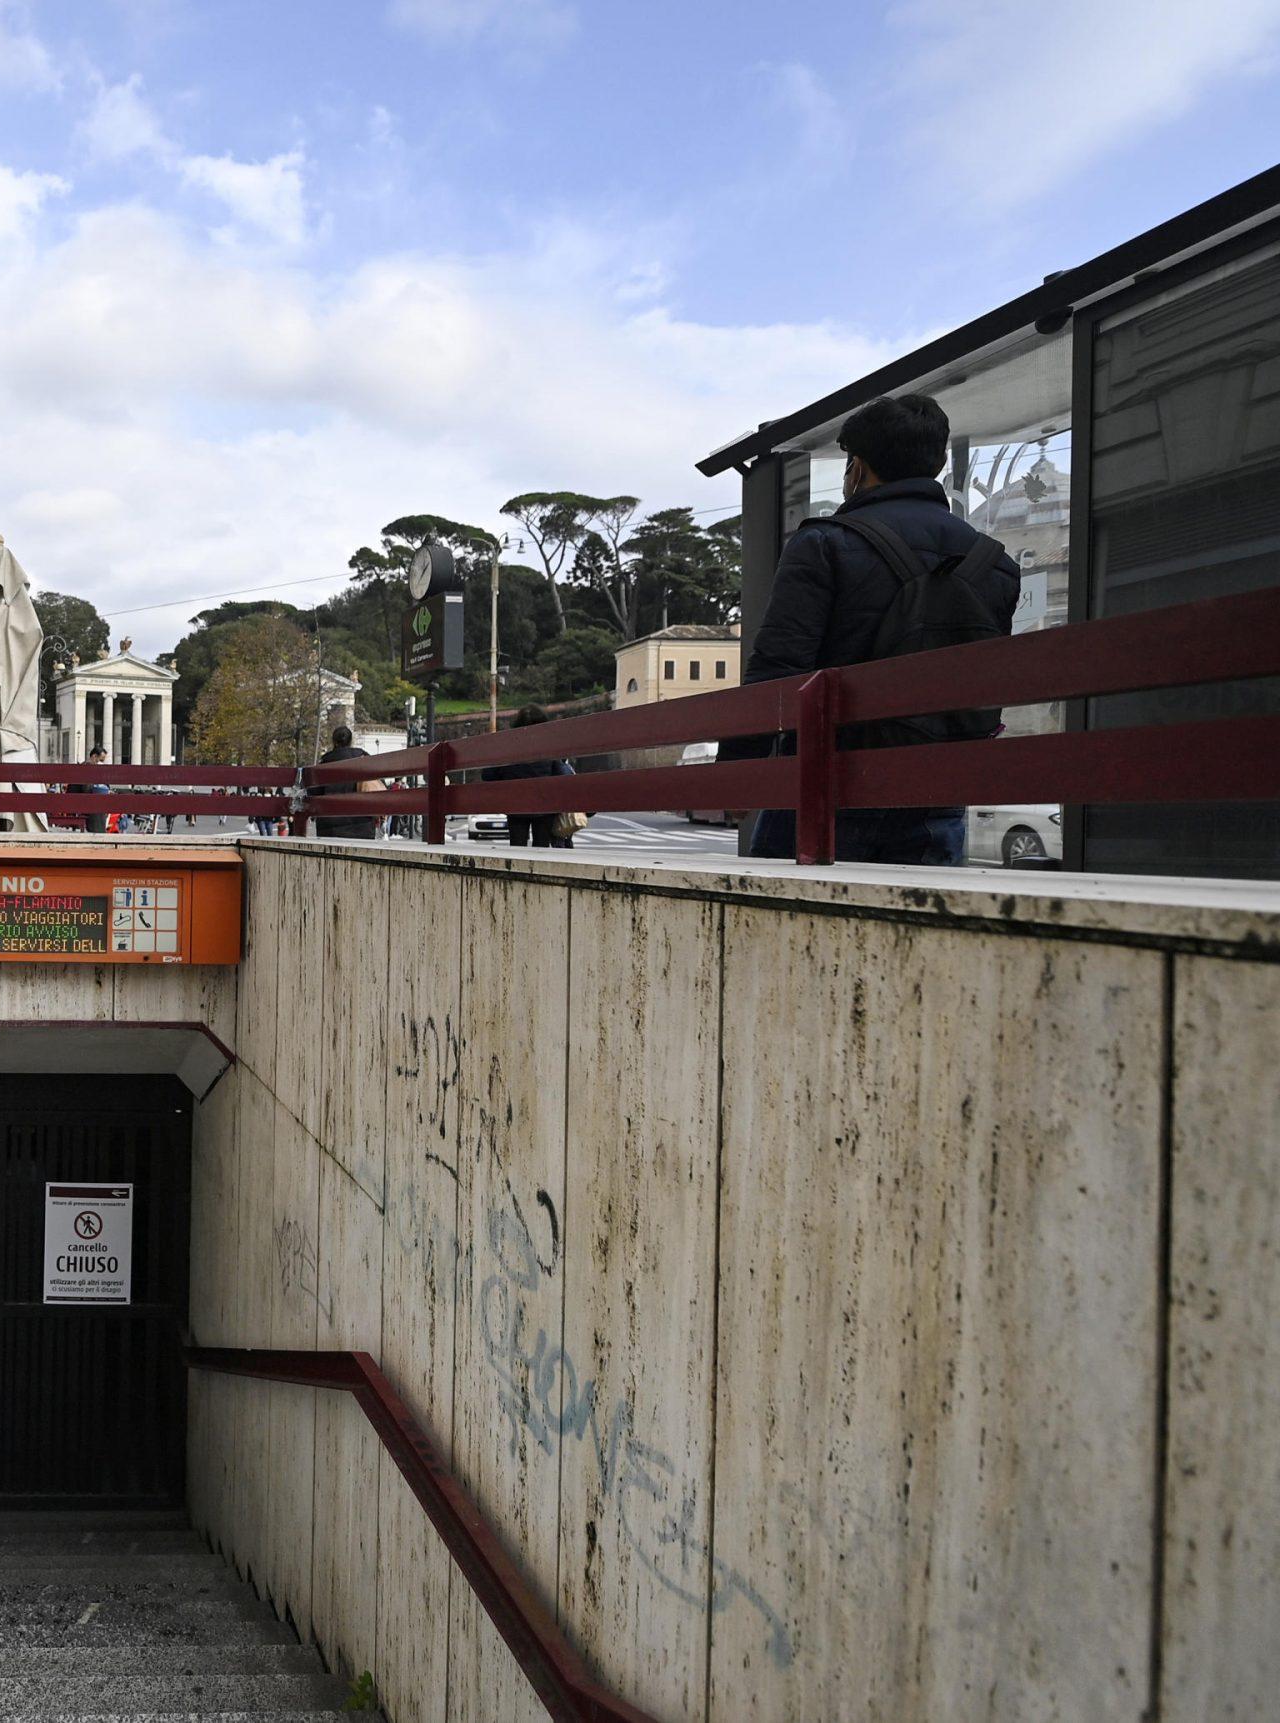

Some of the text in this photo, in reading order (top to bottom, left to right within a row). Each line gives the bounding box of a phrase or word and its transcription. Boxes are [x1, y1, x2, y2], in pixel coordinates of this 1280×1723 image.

[13, 911, 104, 925] VIAGGIATORI
[26, 925, 78, 939] AVVISO
[2, 938, 70, 952] SERVIRSI
[73, 939, 106, 953] DELL
[68, 1243, 108, 1252] cancello
[56, 1256, 118, 1273] CHIUSO
